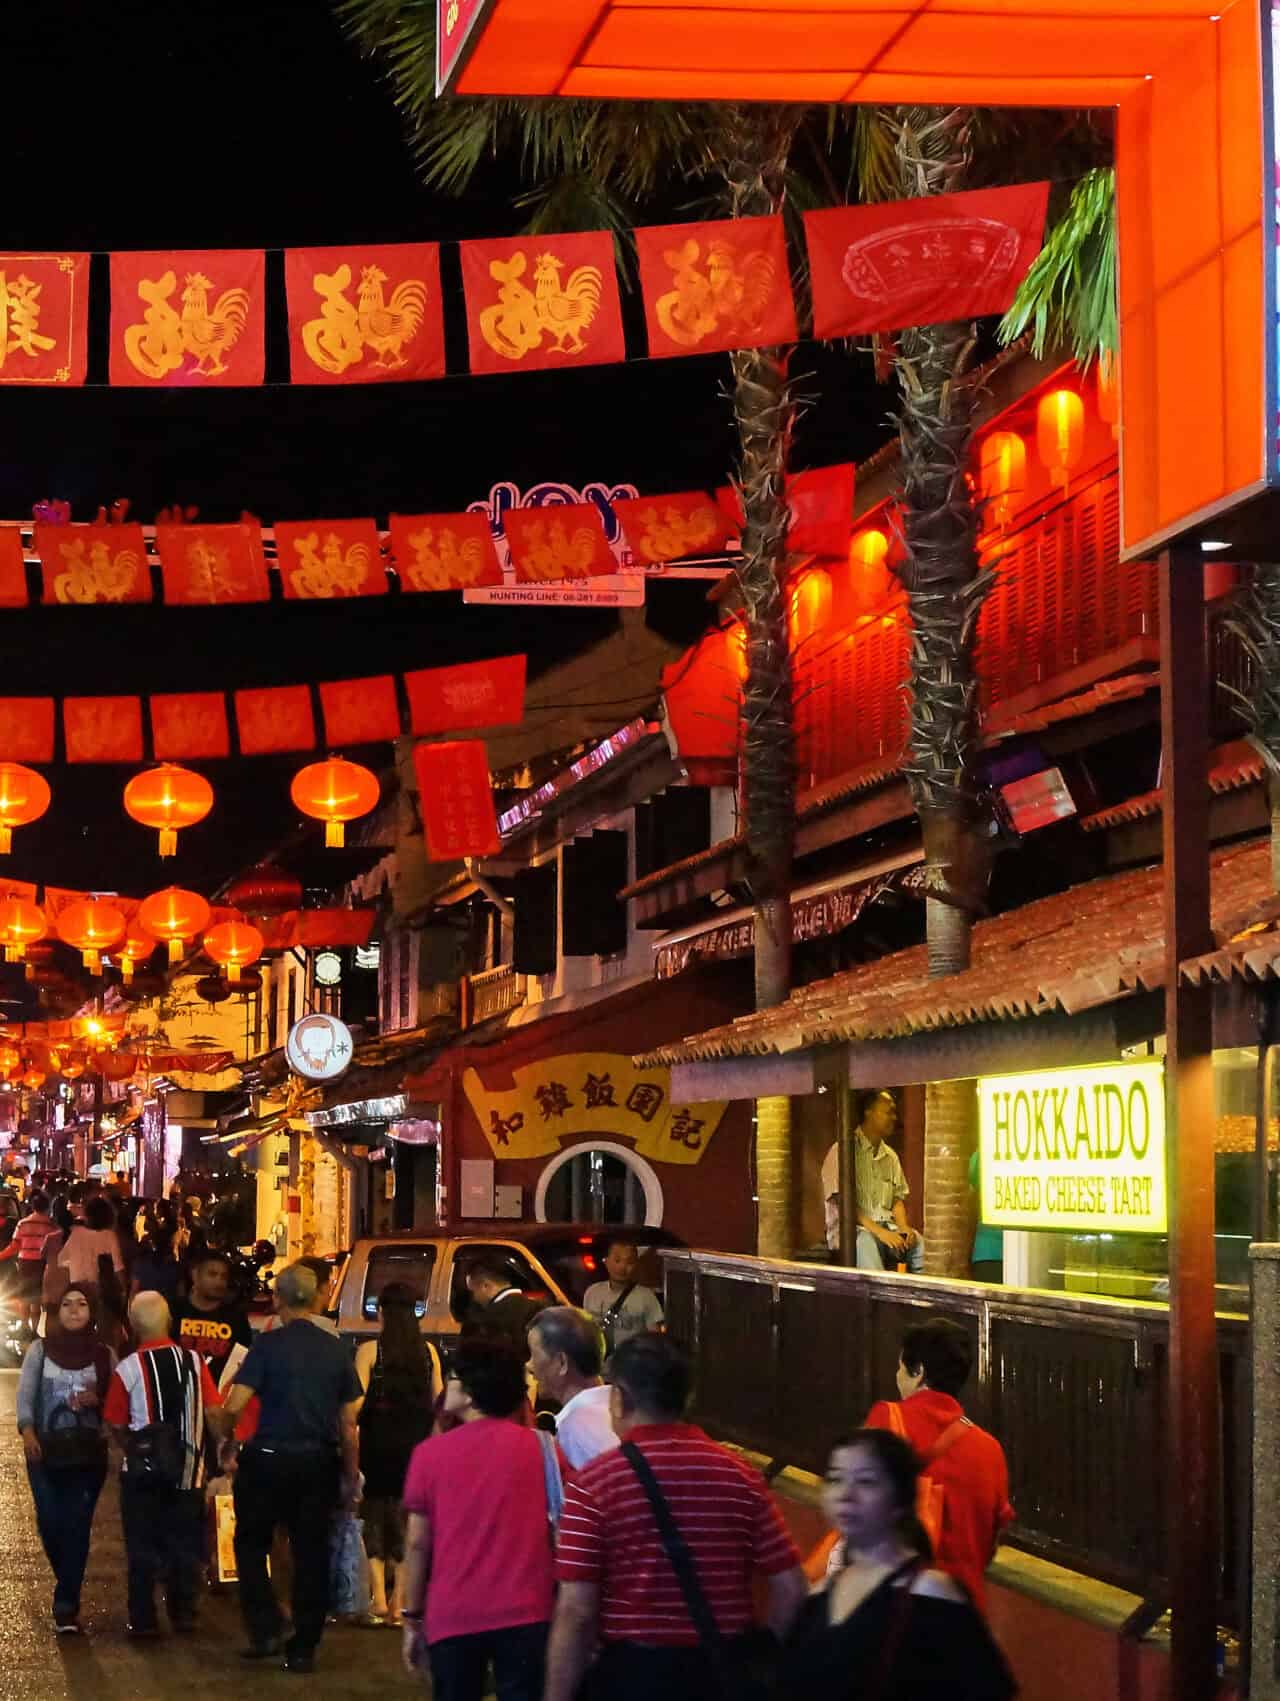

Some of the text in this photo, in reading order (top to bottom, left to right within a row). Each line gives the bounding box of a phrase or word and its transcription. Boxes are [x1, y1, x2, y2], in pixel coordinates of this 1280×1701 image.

[489, 591, 534, 601] HUNTING
[992, 1080, 1150, 1162] HOKKAIDO
[994, 1175, 1153, 1216] BAKED CHEESE TART
[179, 1318, 233, 1341] RETRO
